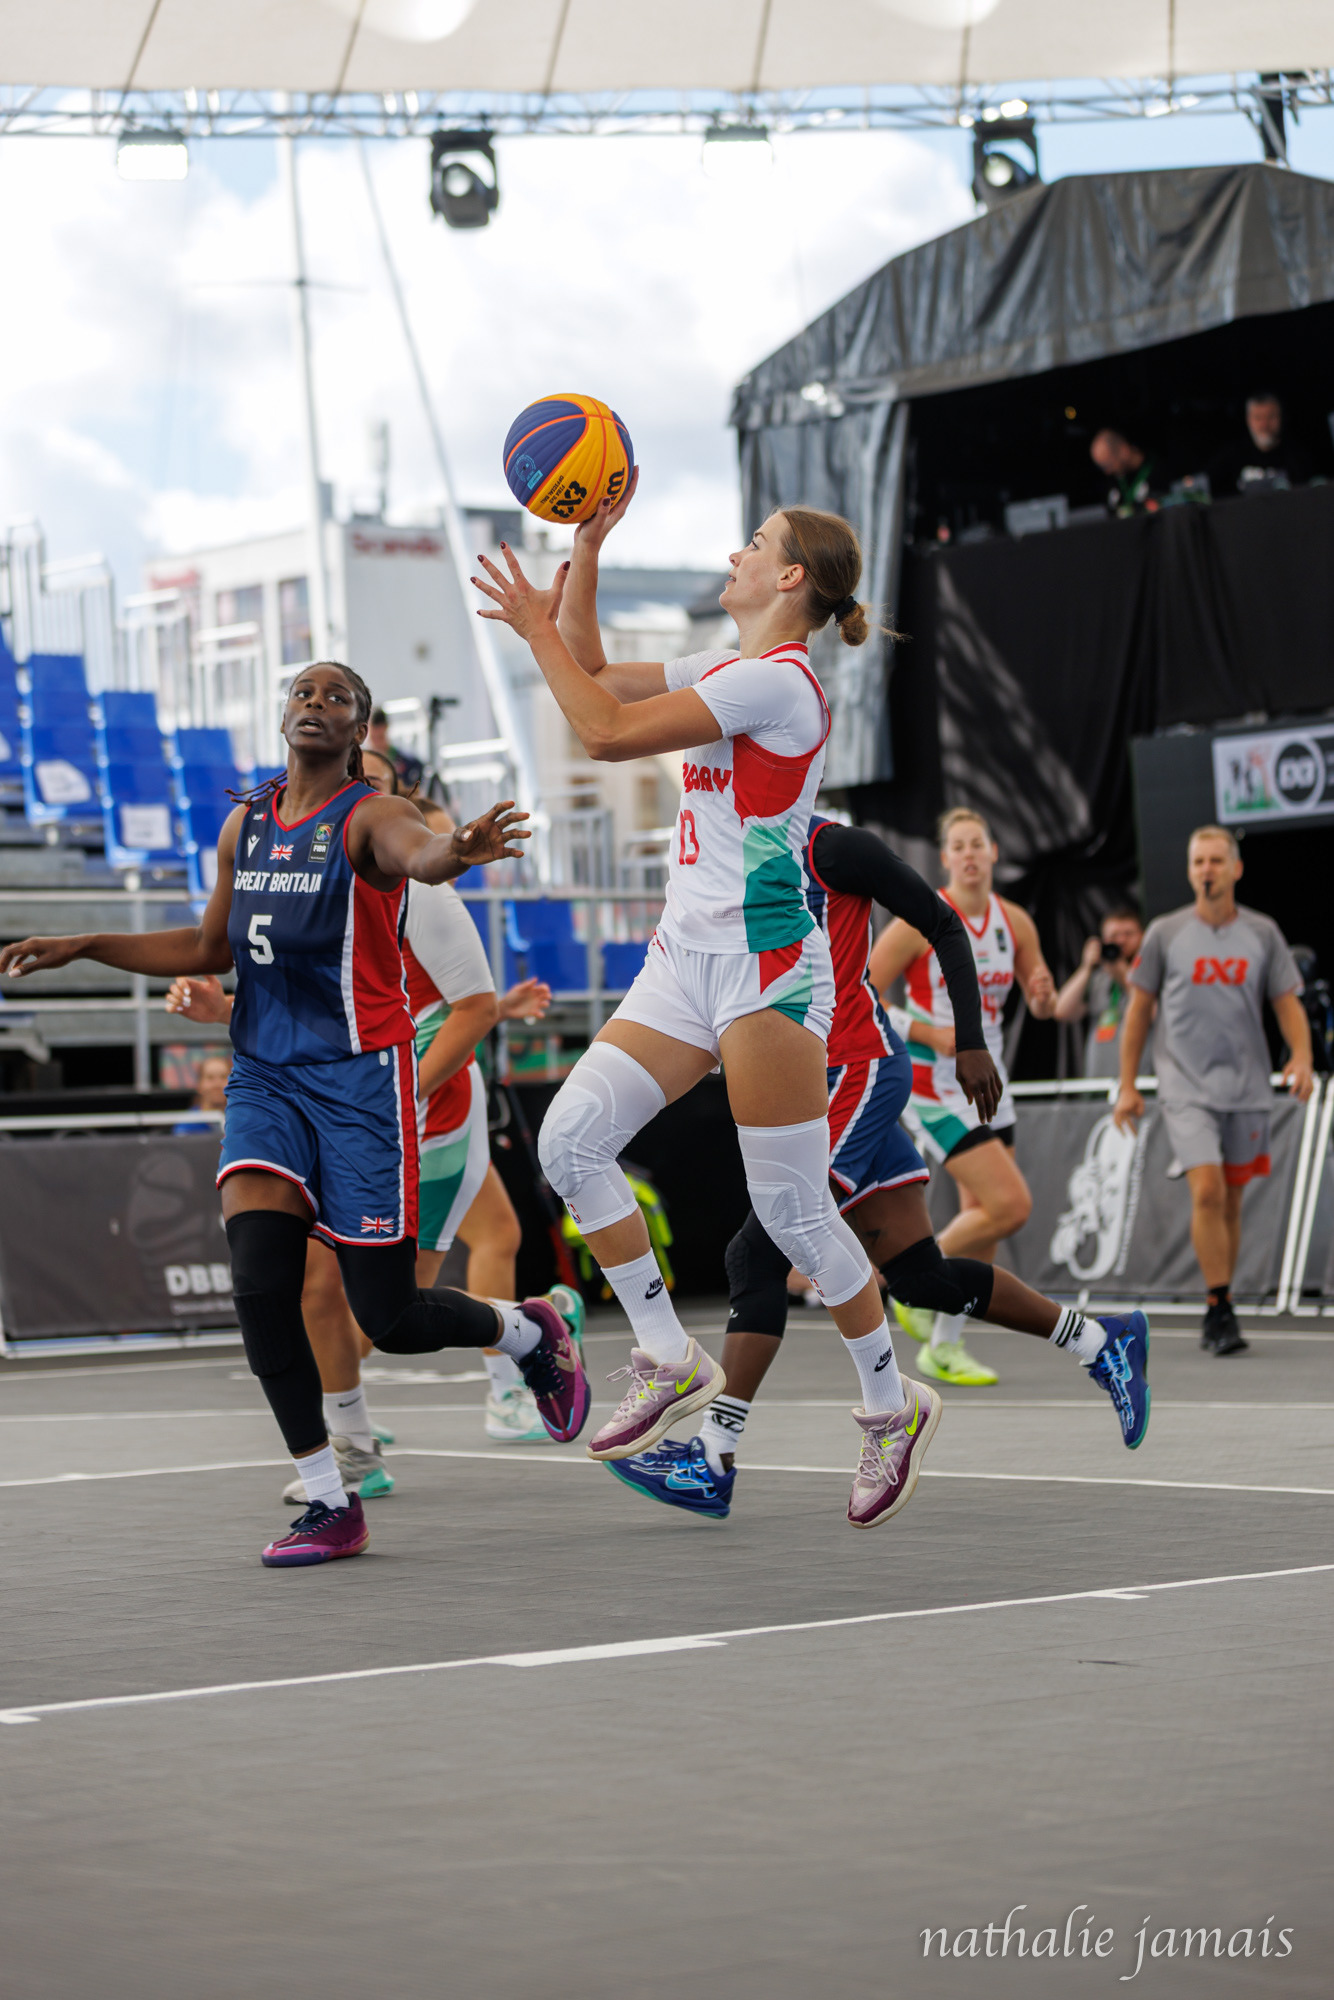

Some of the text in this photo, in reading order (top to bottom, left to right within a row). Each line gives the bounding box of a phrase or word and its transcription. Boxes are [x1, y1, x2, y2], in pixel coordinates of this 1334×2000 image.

[234, 870, 322, 893] GREAT BRITAIN
[247, 914, 275, 964] 5
[164, 1264, 233, 1296] DBB
